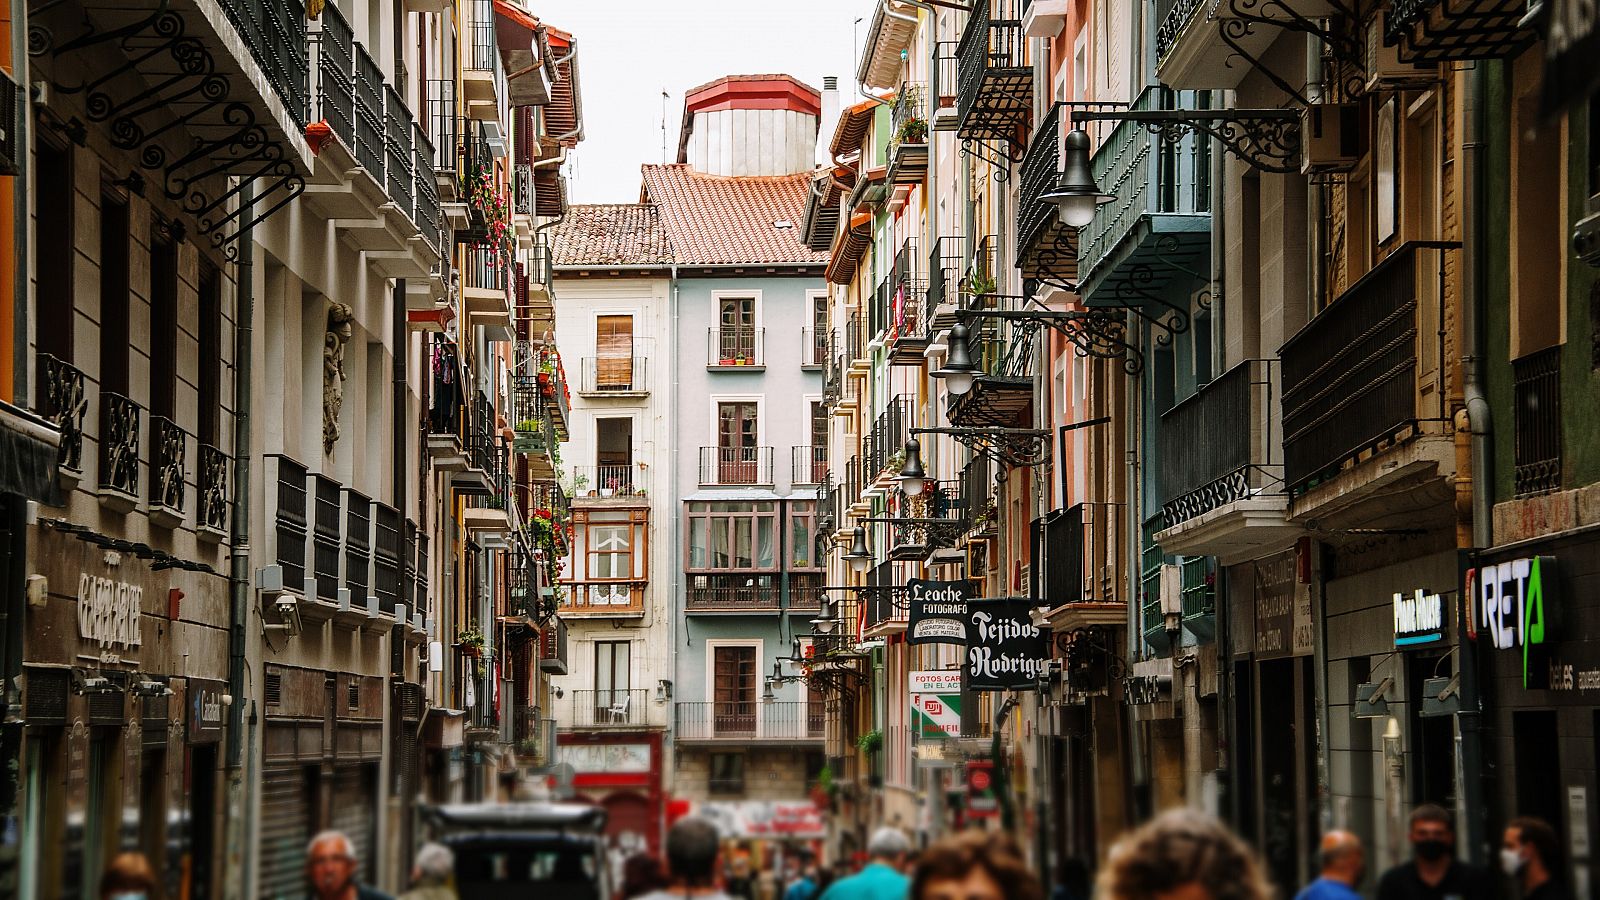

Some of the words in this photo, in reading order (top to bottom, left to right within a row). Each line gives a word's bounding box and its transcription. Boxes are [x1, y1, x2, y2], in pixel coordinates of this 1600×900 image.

[913, 584, 963, 603] Leache
[922, 603, 968, 615] FOTOGRAFO
[971, 611, 1041, 646] Tejidos
